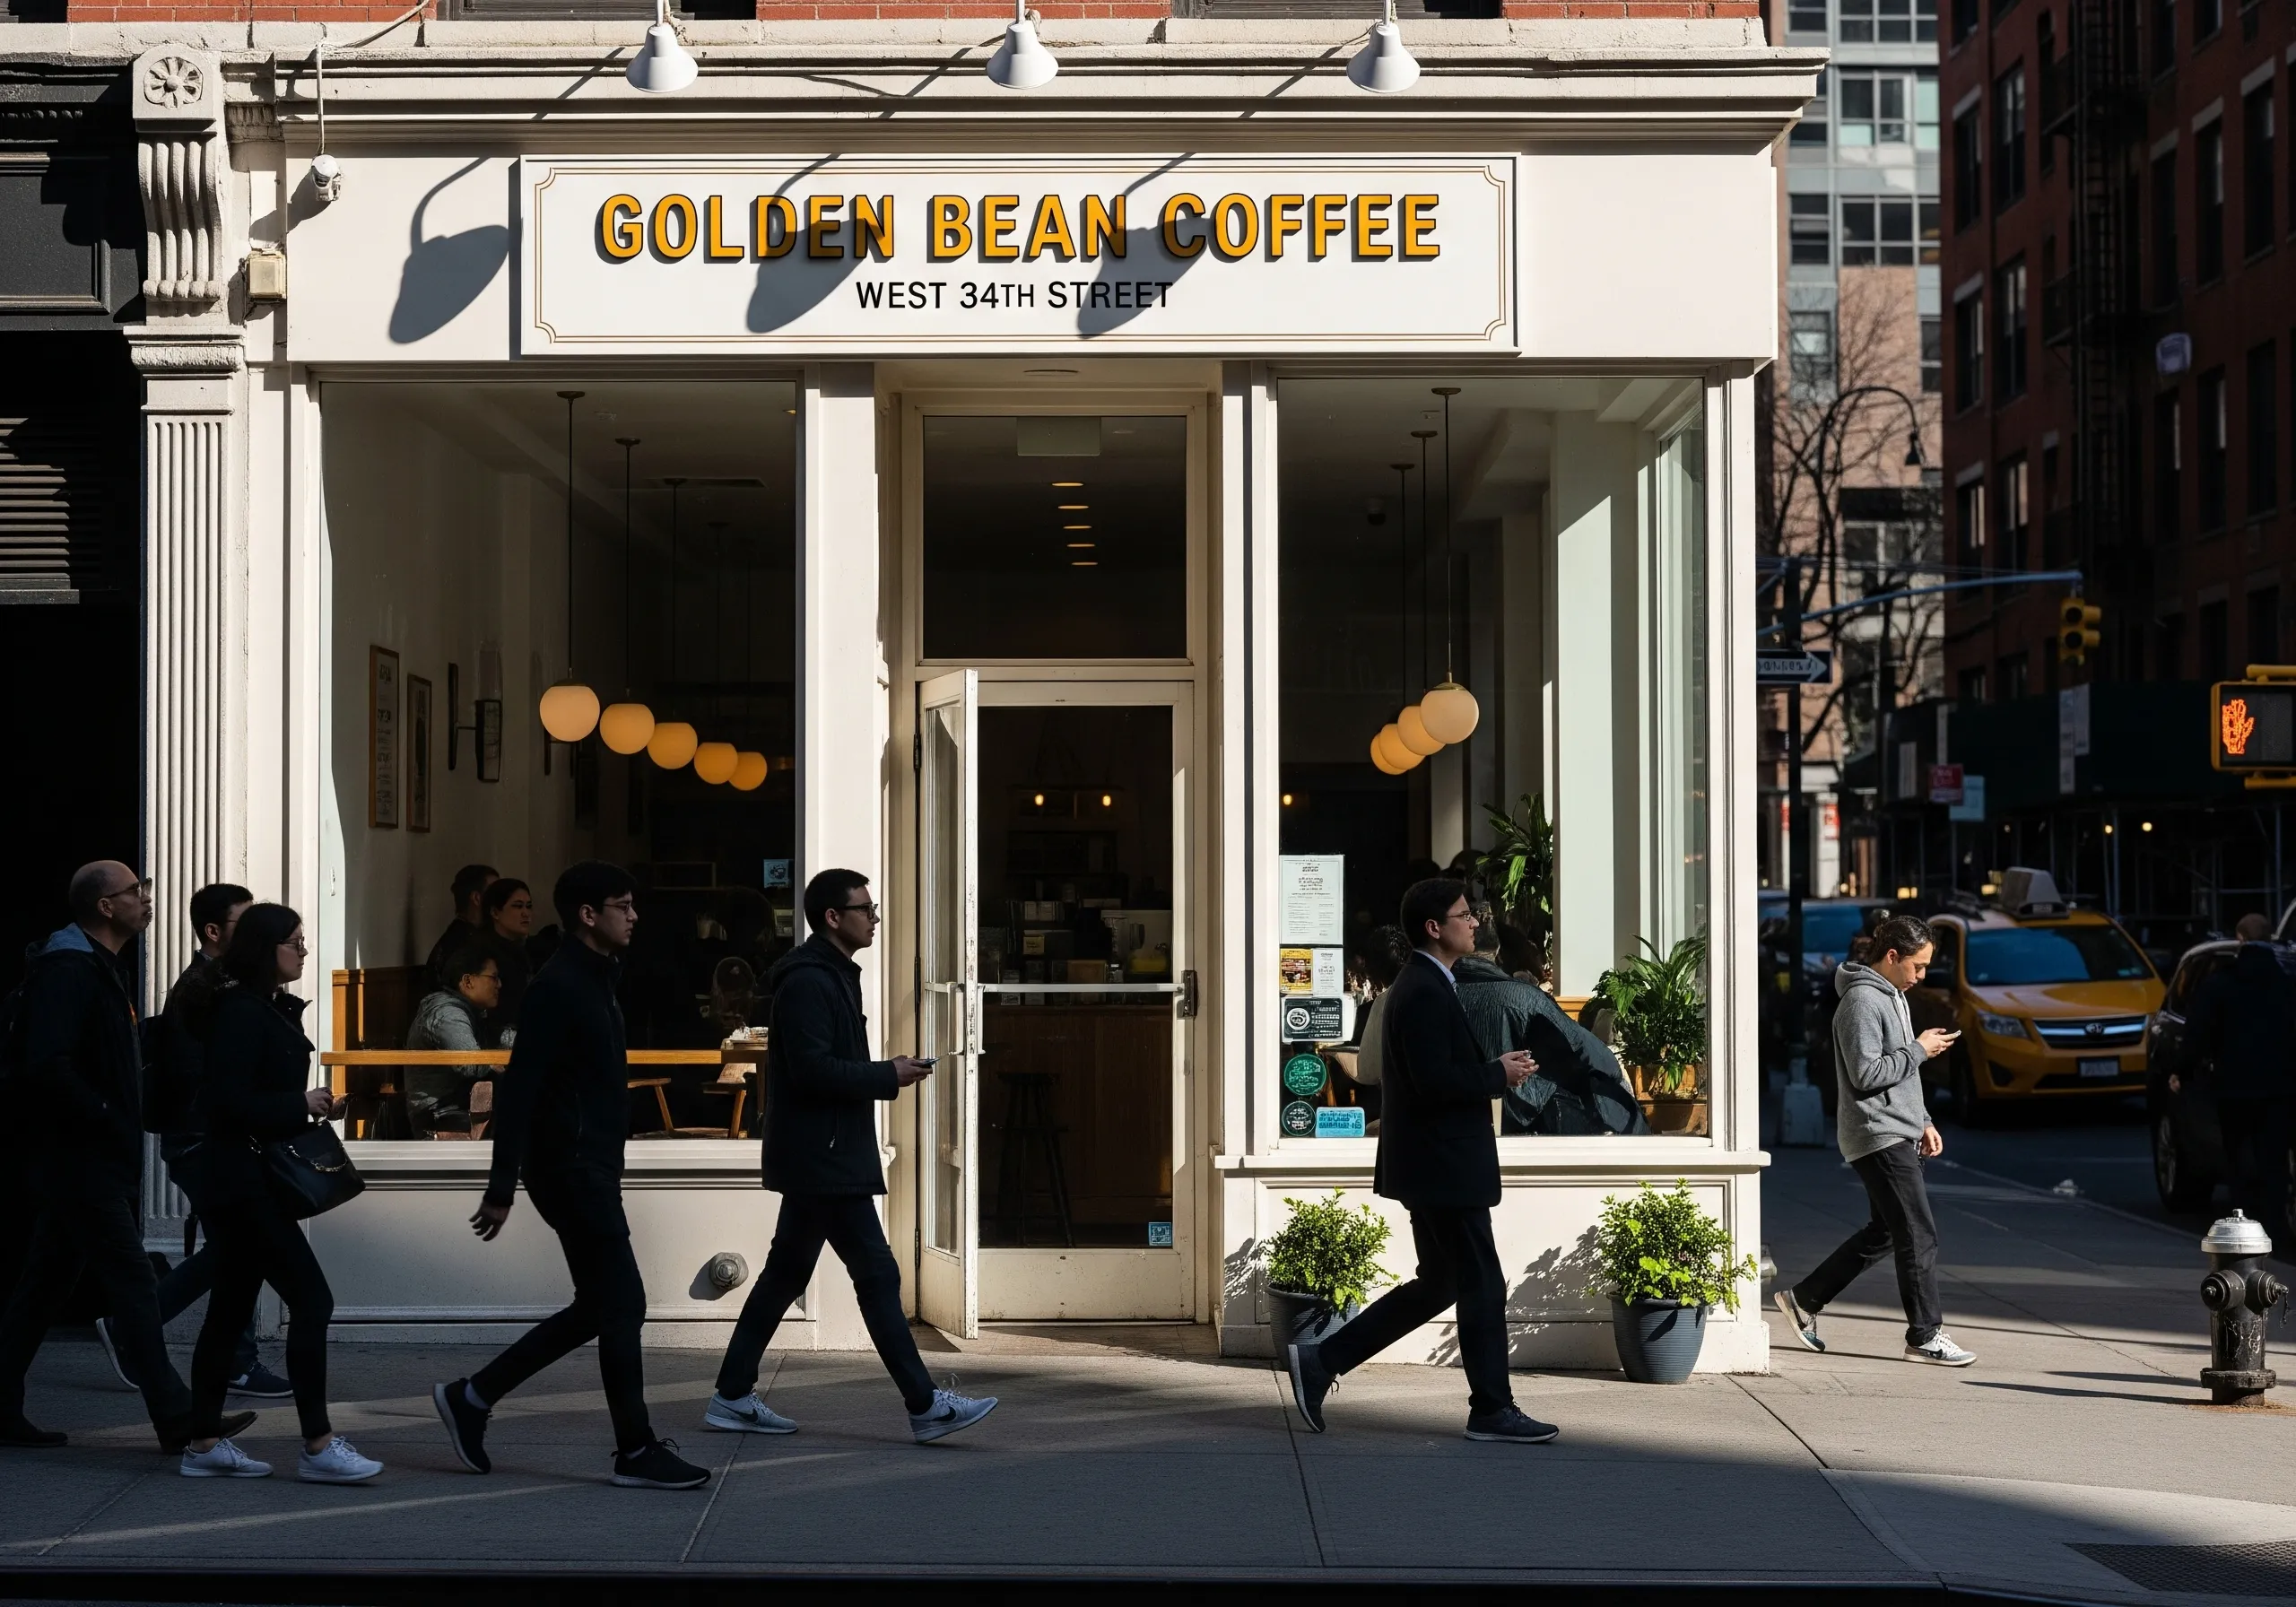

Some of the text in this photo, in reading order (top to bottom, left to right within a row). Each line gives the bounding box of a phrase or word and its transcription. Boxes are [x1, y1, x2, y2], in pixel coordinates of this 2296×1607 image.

[599, 192, 1441, 259] GOLDEN BEAN COFFEE
[856, 281, 1174, 309] WEST 34TH STREET
